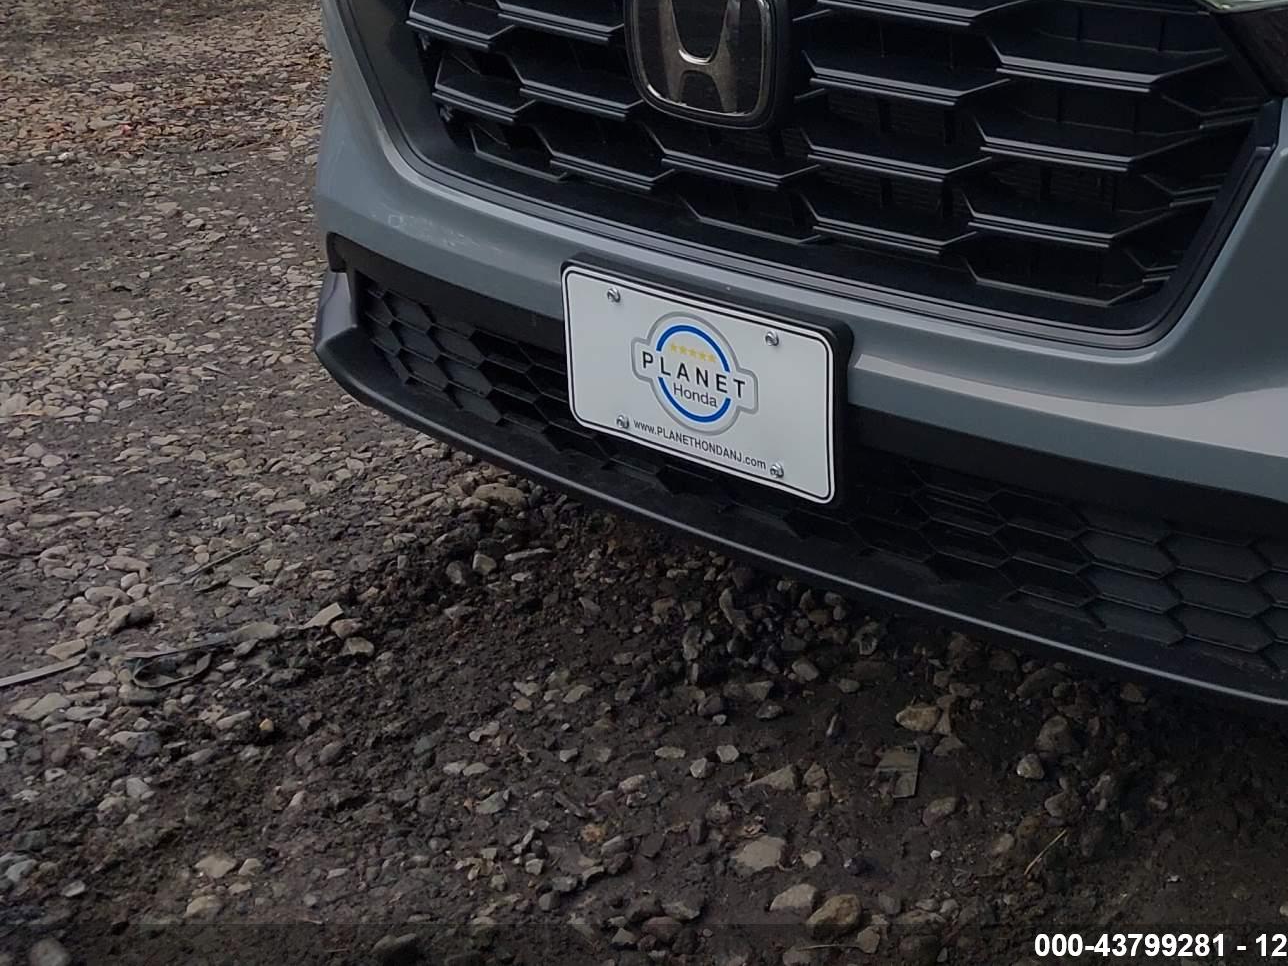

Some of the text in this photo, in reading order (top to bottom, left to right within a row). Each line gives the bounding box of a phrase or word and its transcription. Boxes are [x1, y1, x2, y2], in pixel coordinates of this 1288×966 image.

[642, 351, 746, 398] PLANET
[673, 382, 718, 408] Honda
[633, 420, 766, 470] www.PLANETHONDANJ.com
